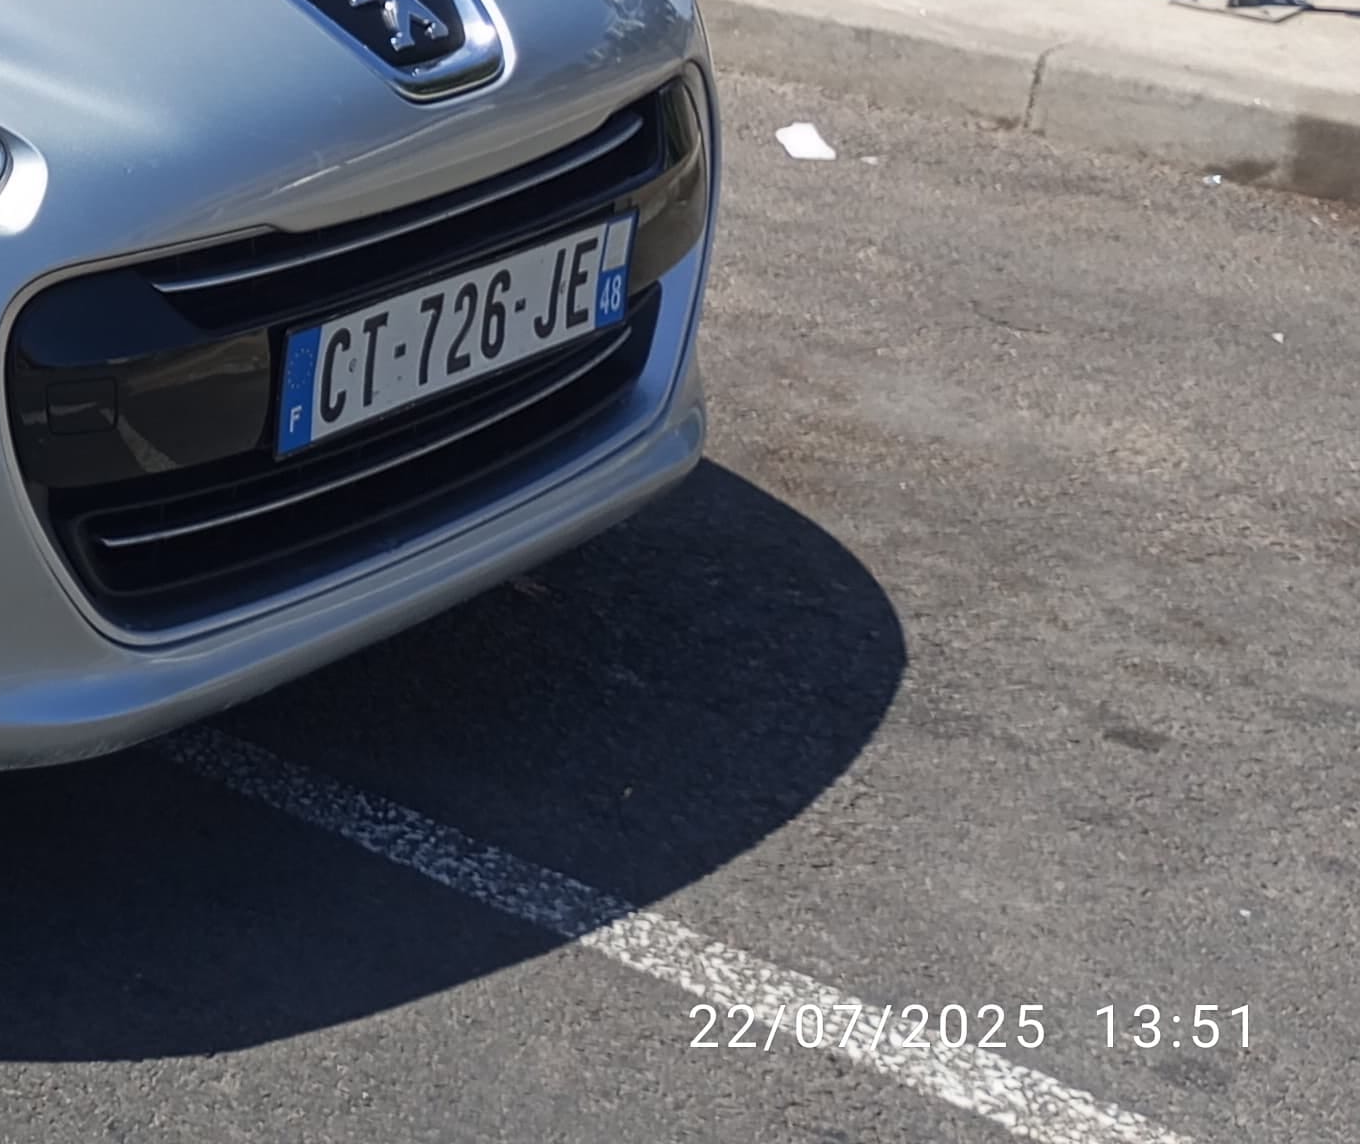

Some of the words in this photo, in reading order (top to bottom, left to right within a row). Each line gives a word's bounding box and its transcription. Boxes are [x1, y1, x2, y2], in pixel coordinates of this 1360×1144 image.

[319, 237, 599, 425] CT-726-JE
[598, 273, 623, 316] 48
[289, 405, 303, 435] F
